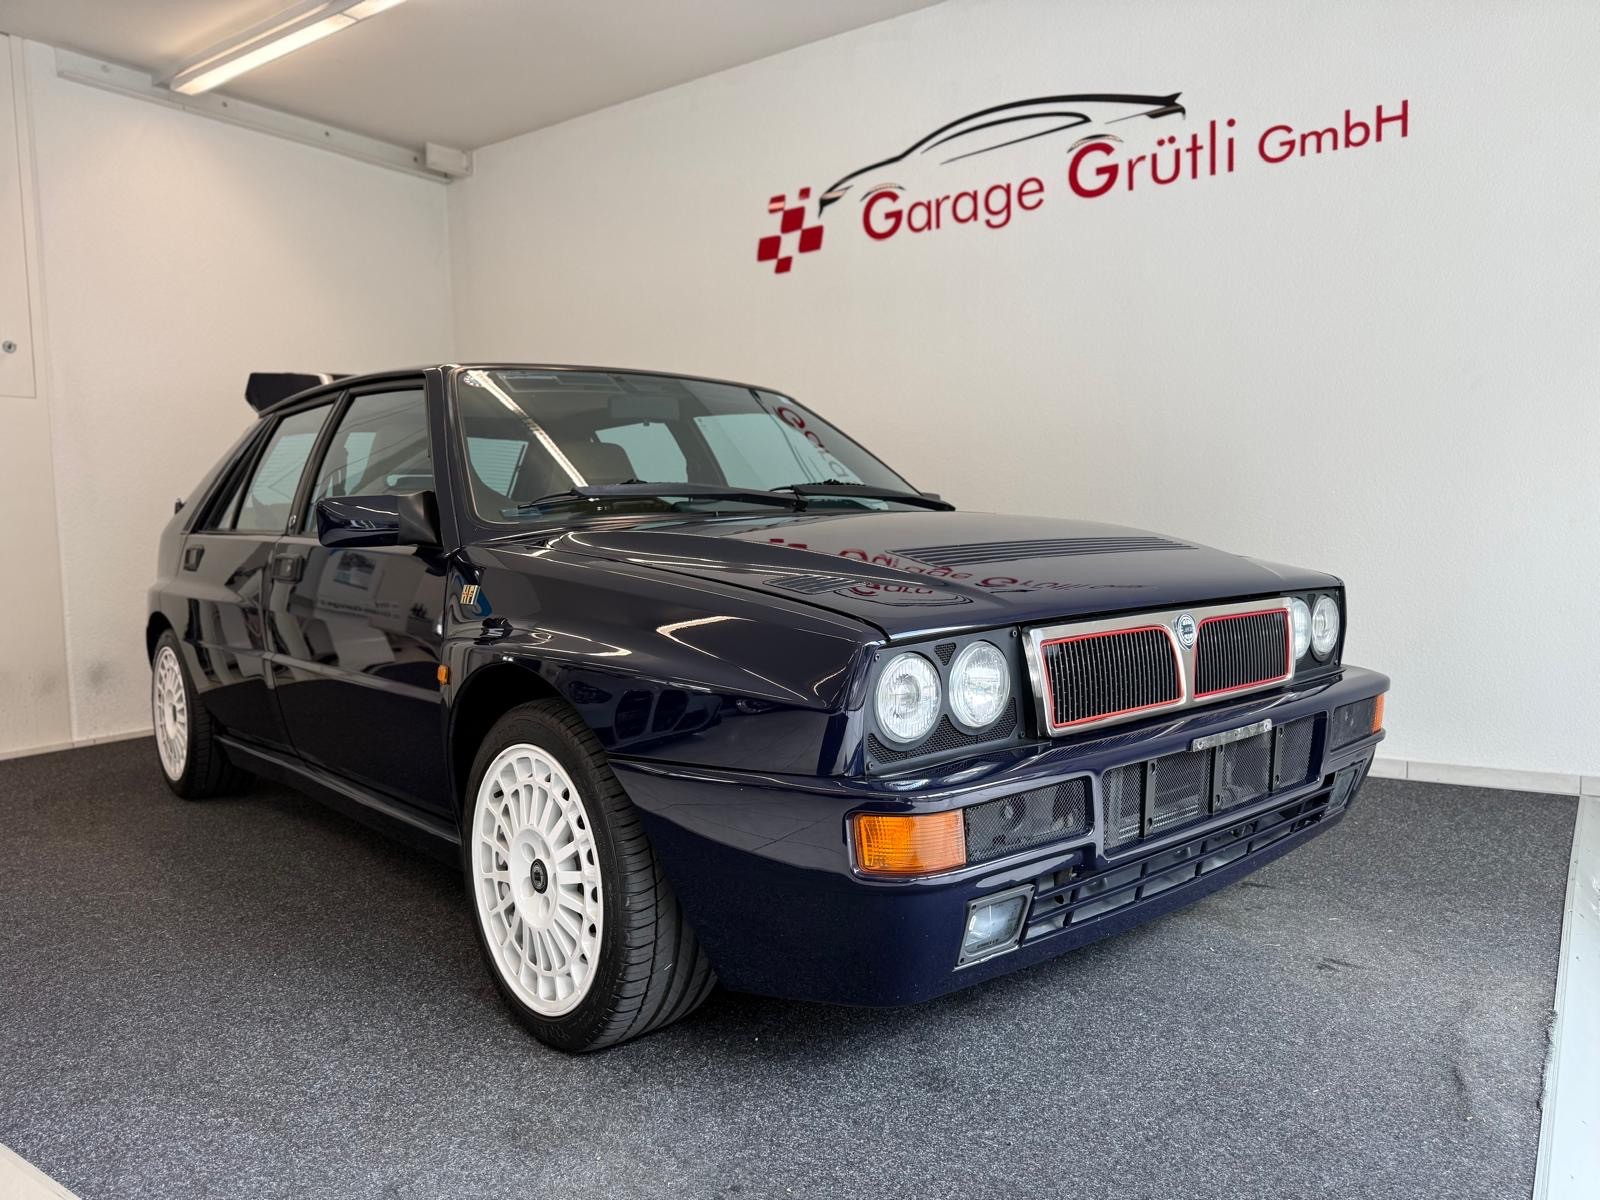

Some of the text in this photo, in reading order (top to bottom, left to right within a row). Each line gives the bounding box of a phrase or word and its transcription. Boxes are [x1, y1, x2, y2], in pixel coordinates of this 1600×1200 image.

[862, 99, 1410, 241] Garage Grütli GmbH
